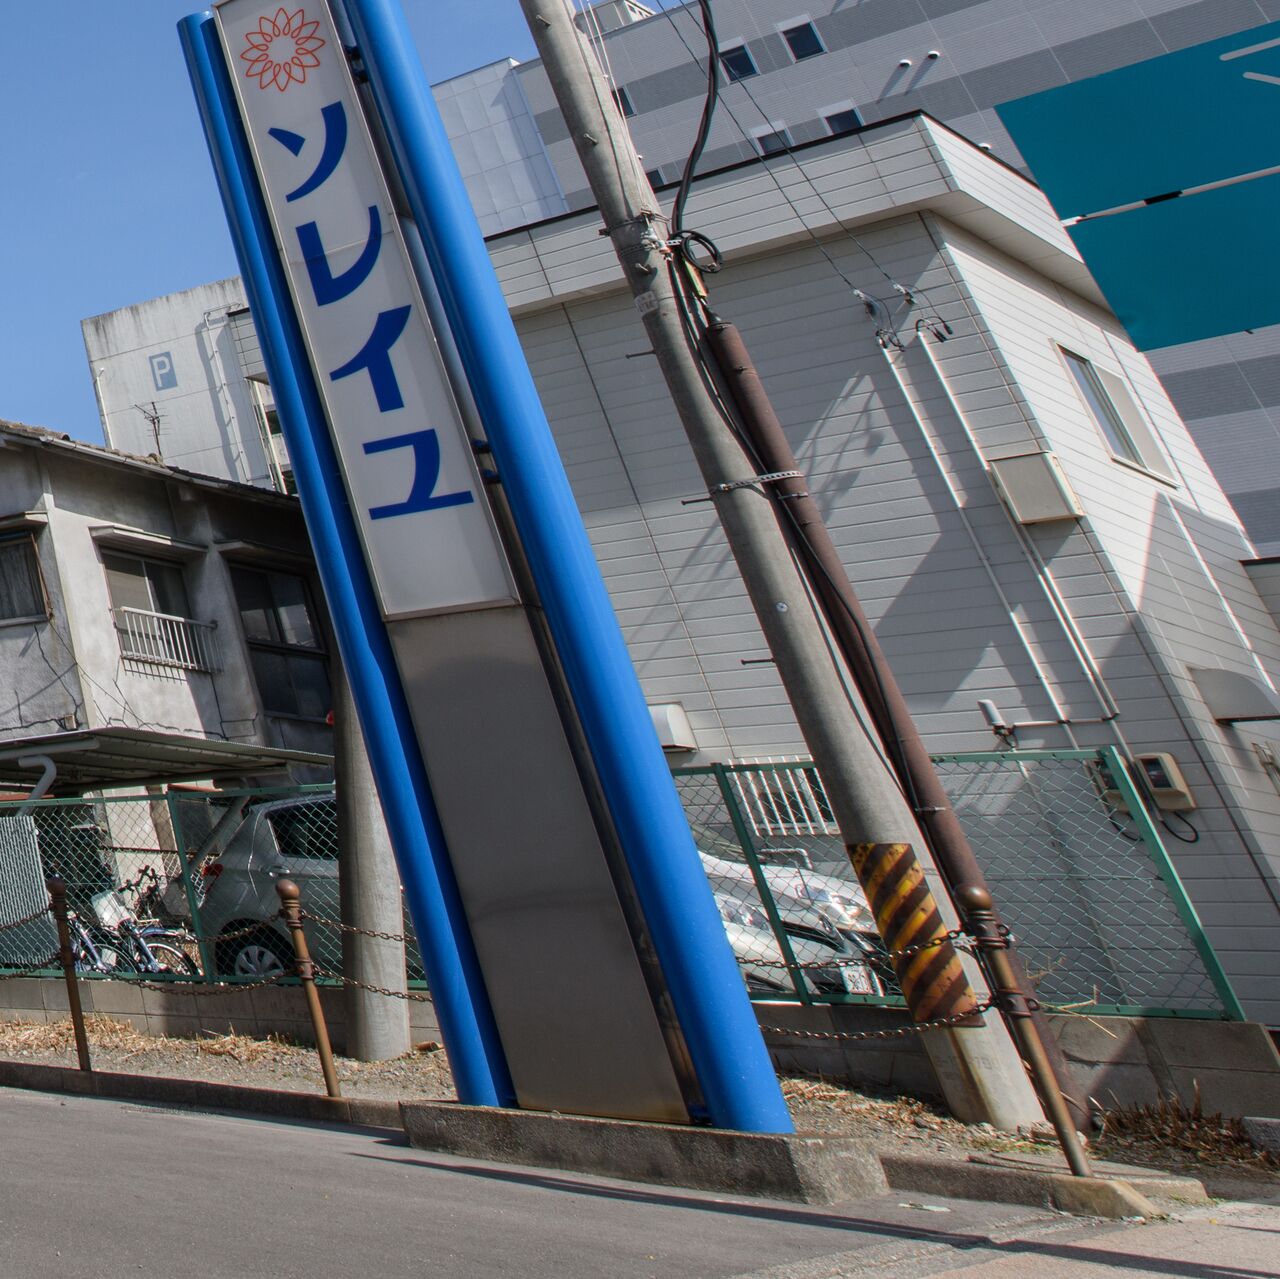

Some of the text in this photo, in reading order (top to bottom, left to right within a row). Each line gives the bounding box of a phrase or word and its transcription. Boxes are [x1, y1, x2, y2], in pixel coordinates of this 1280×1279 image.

[151, 355, 171, 388] P
[268, 101, 474, 520] ソレイユ
